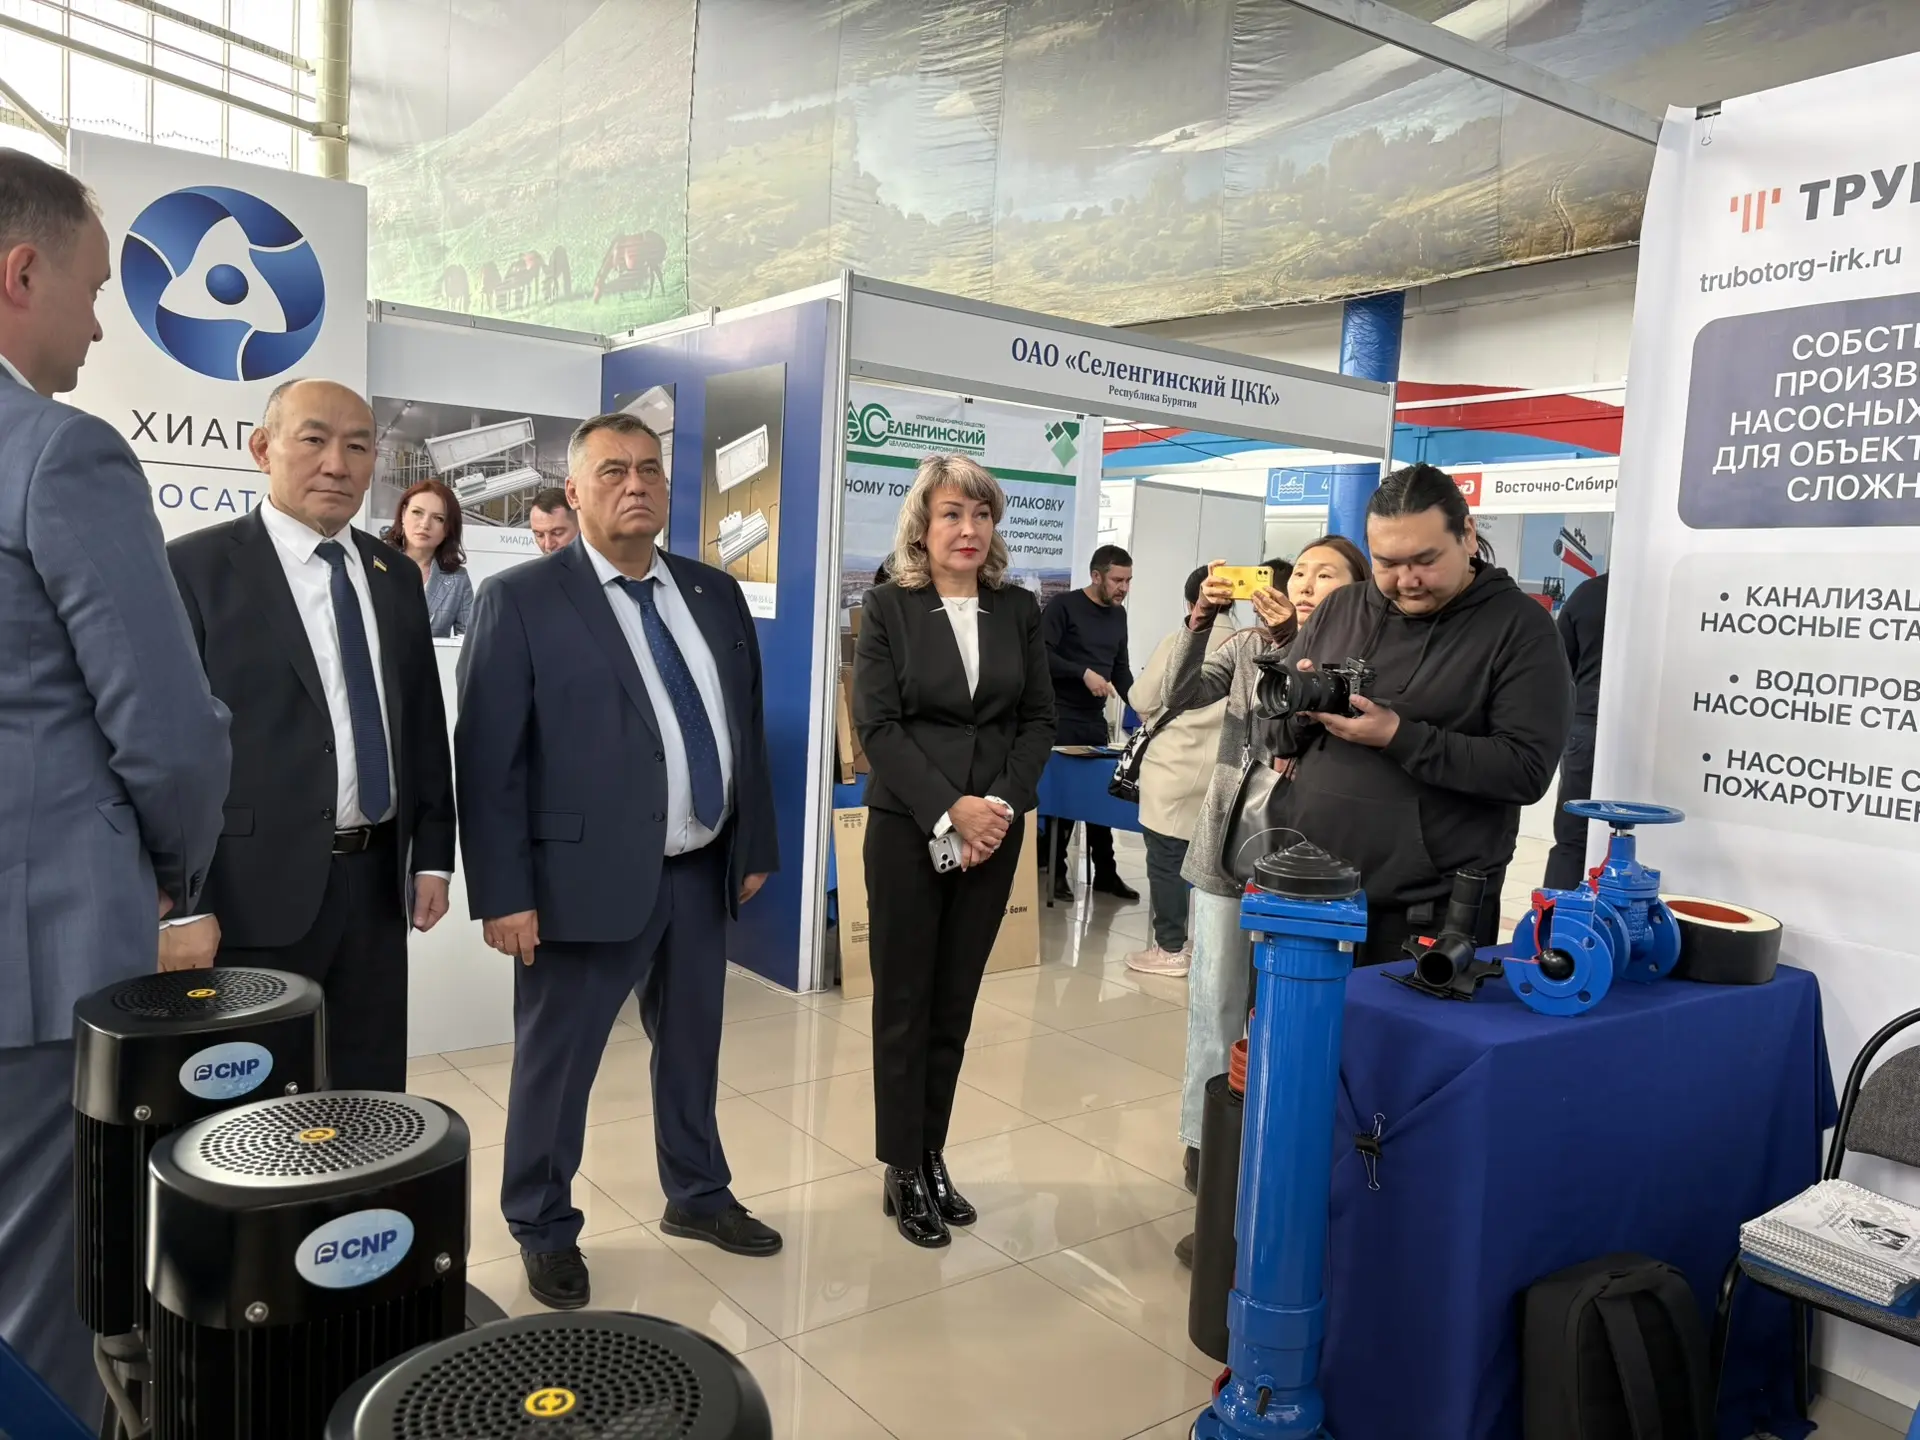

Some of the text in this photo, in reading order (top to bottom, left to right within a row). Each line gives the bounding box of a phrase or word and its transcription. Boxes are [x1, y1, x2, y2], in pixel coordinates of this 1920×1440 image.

[1700, 246, 1902, 292] trubotorg-irk.ru
[1011, 337, 1280, 406] ОАО «Селенгинский ЦКК»
[1774, 360, 1920, 398] ПРОИЗВ
[1108, 384, 1198, 409] Республика Бурятия
[131, 409, 254, 451] ХИАГ
[1712, 443, 1781, 475] ДЛЯ
[158, 483, 257, 513] ОСАТ
[845, 479, 885, 495] НОМУ
[1010, 516, 1063, 528] ТАРНЫЙ КАРТОН
[1008, 545, 1063, 556] КАЯ ПРОДУКЦИЯ
[1700, 612, 1861, 639] НАСОСНЫЕ
[1693, 691, 1918, 733] НАСОСНЫЕ СТА
[1726, 749, 1893, 790] НАСОСНЫЕ
[214, 1058, 260, 1079] CNP
[341, 1229, 398, 1259] CNP
